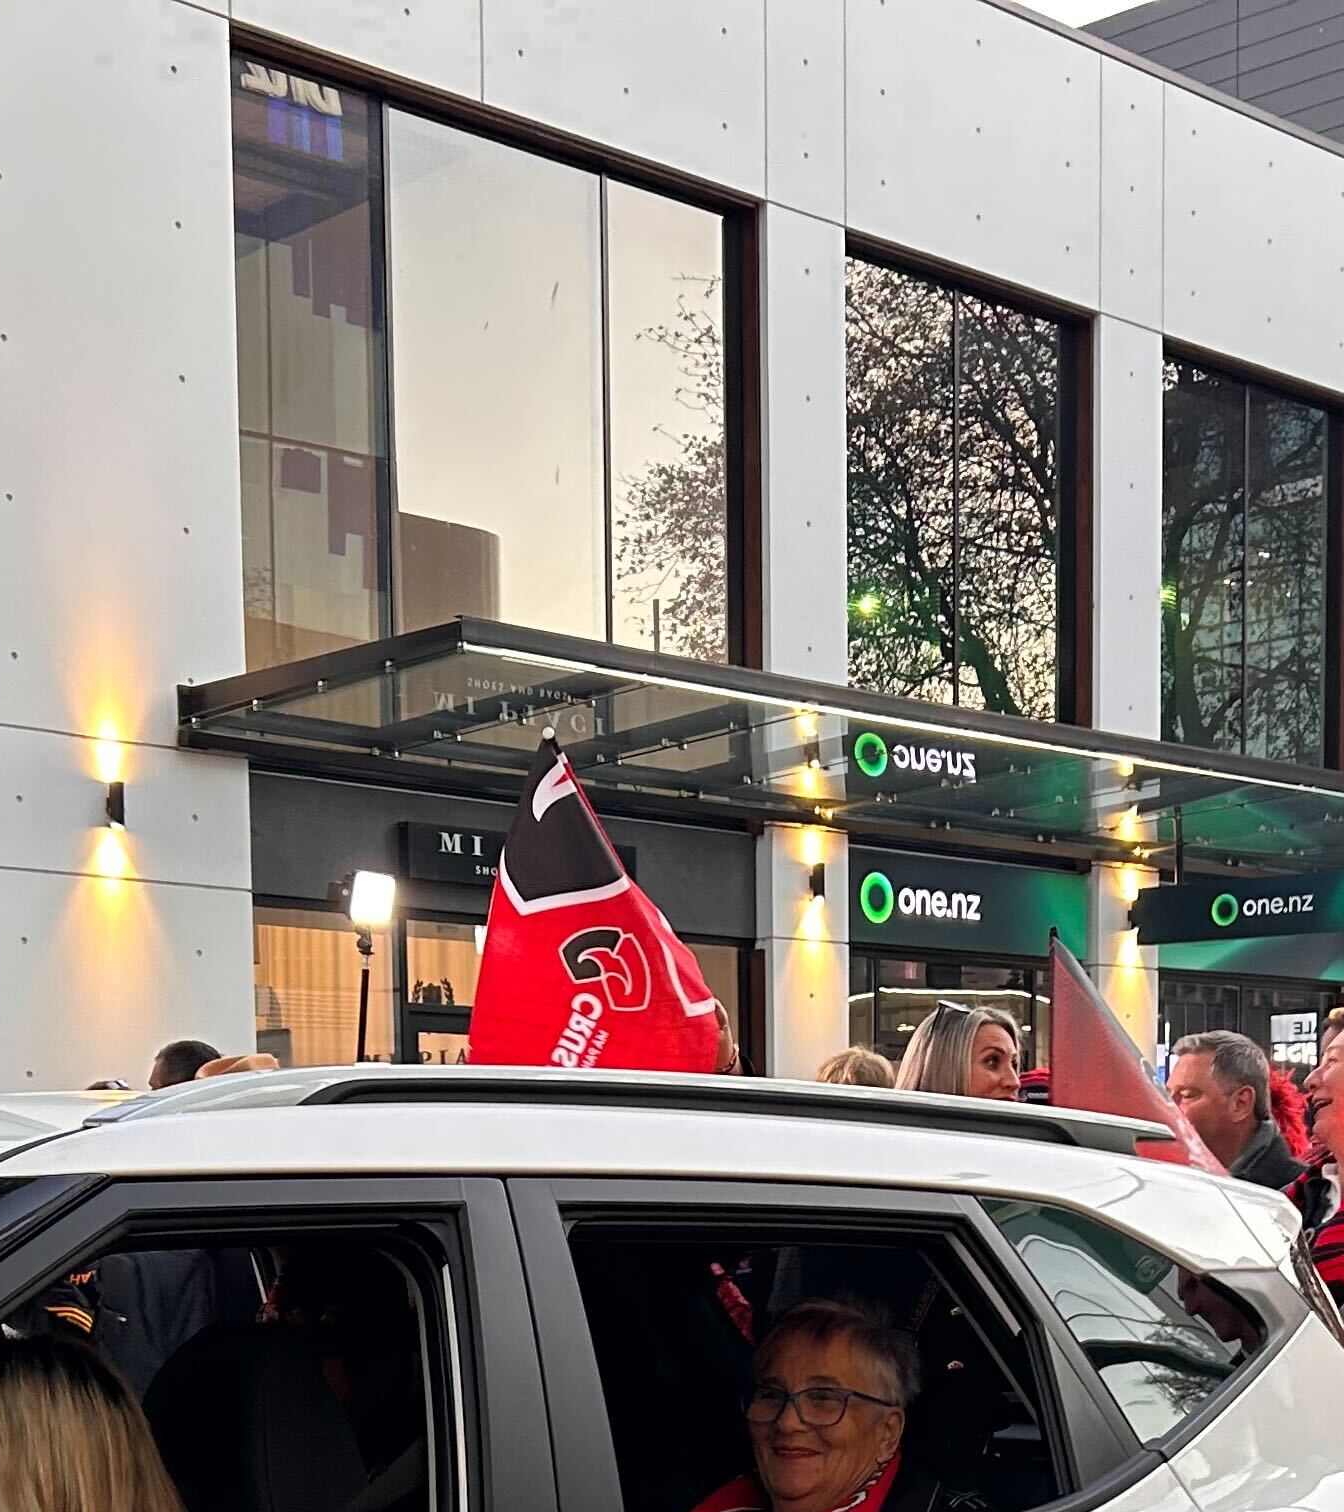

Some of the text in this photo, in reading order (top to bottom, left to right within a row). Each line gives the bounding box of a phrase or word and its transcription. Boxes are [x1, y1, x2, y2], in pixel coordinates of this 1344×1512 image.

[437, 831, 486, 857] MI
[897, 886, 981, 921] one.nz
[1242, 893, 1314, 917] one.nz
